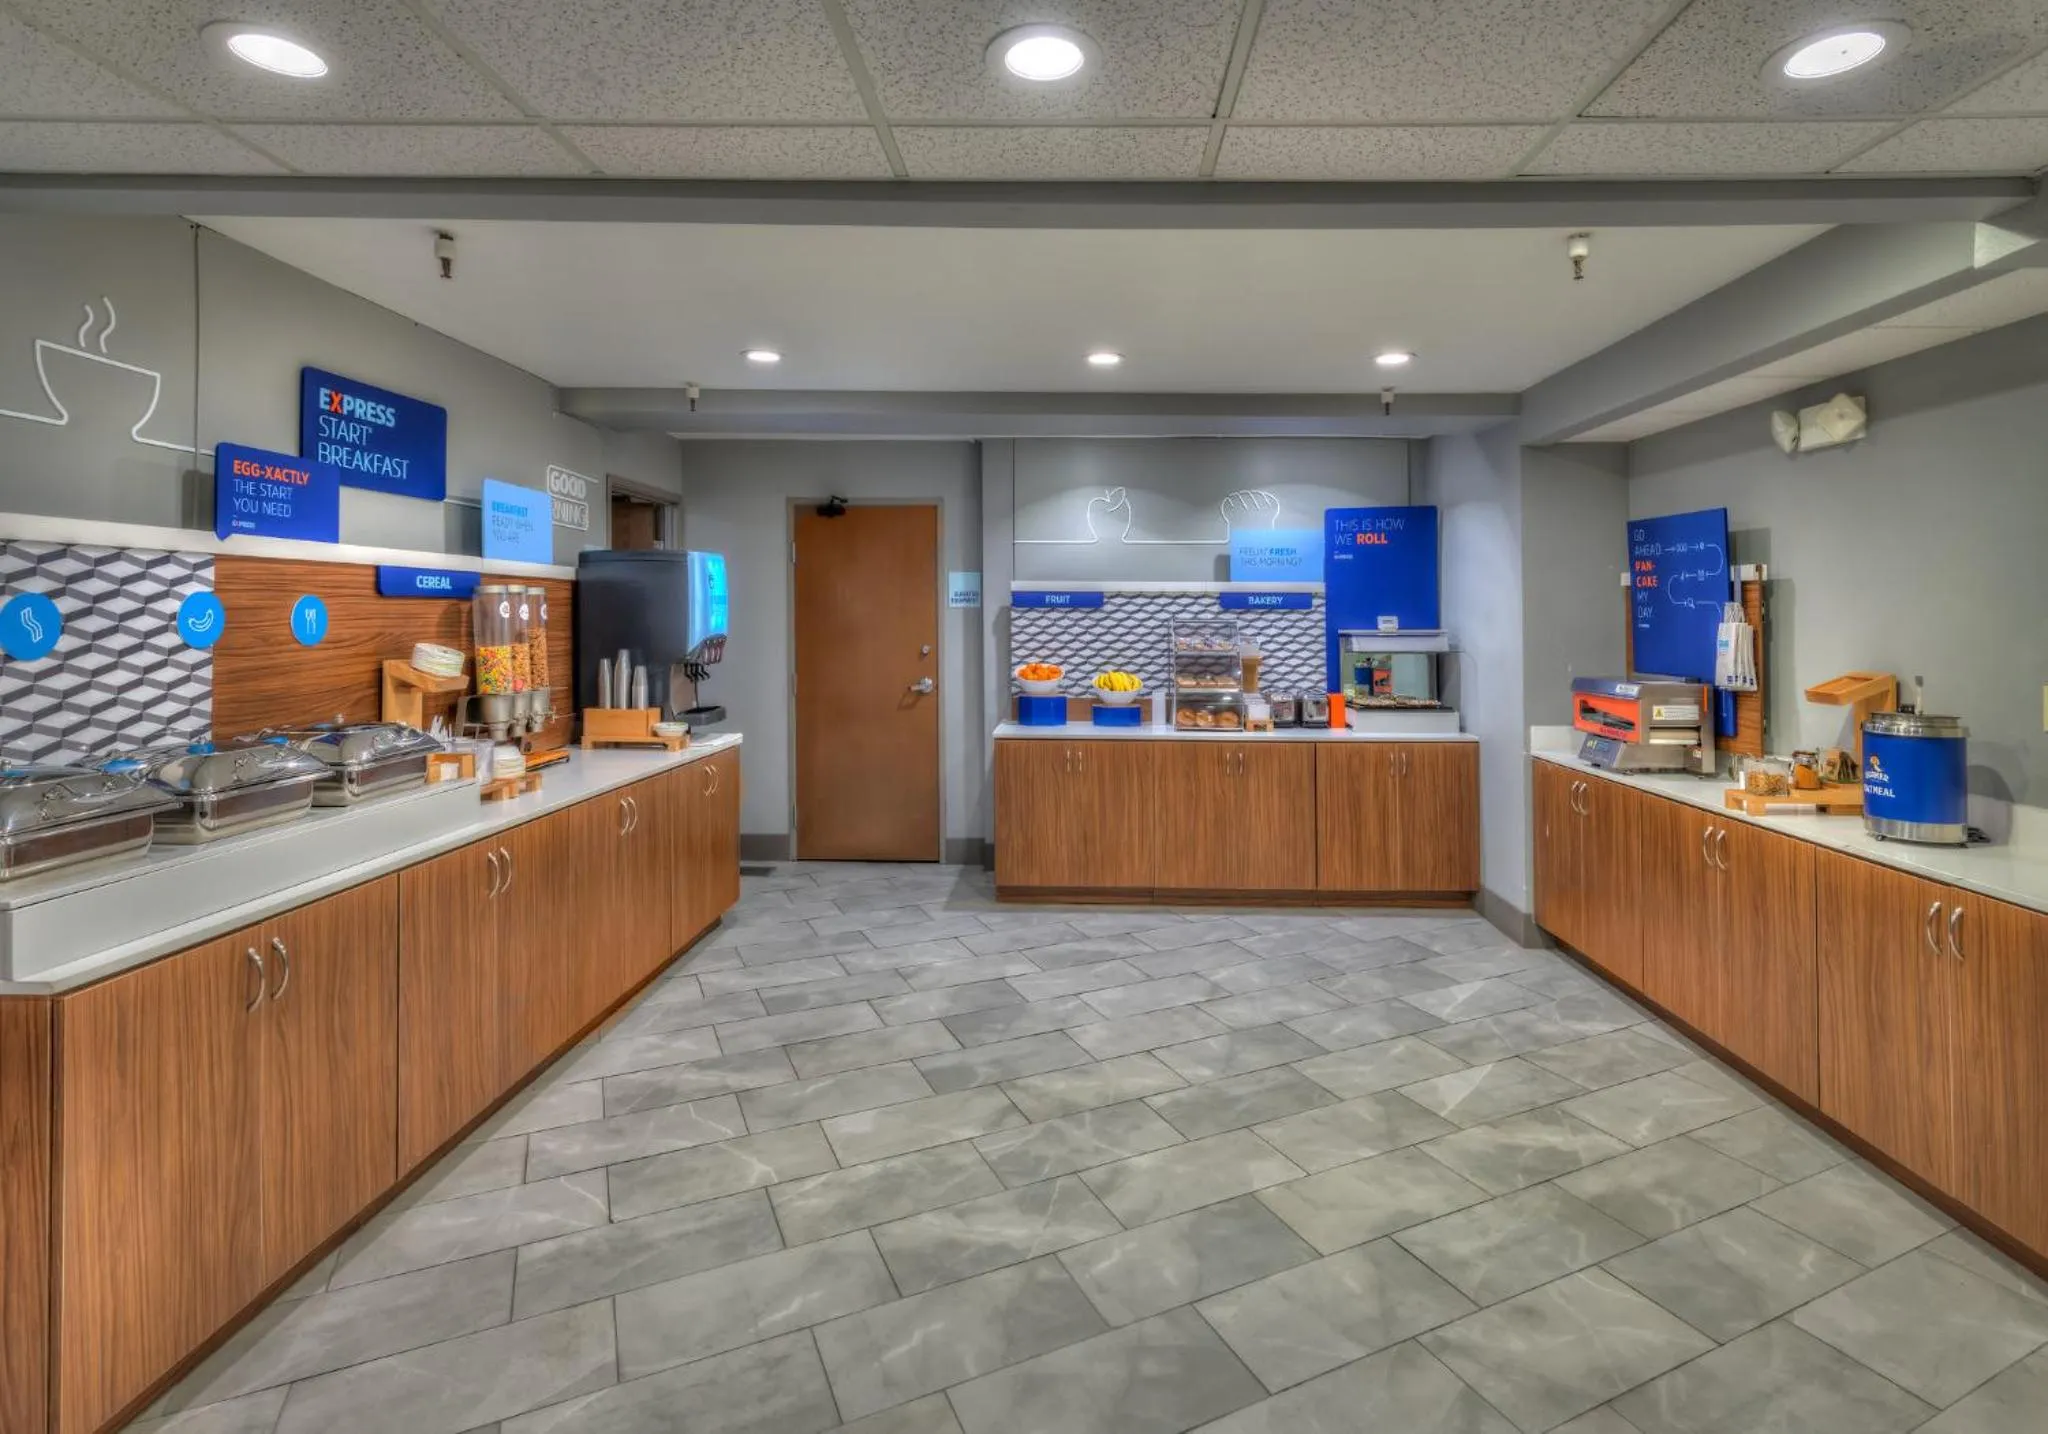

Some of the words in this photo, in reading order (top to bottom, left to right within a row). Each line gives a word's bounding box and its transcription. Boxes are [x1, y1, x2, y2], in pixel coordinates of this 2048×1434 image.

[320, 387, 396, 428] EXPRESS
[318, 442, 410, 480] BREAKFAST
[233, 459, 310, 485] EGG-XACTLY
[233, 479, 257, 496] THE
[260, 483, 293, 501] START
[551, 470, 587, 500] GOOD
[233, 497, 259, 514] YOU
[262, 502, 292, 518] NEED
[1335, 519, 1359, 530] THIS
[1361, 519, 1372, 530] IS
[1375, 518, 1405, 530] HOW
[1335, 533, 1353, 545] WE
[1356, 533, 1388, 545] ROLL
[1633, 529, 1645, 541] GO
[1269, 547, 1297, 556] FRESH
[1635, 543, 1661, 557] AHEAD
[1635, 560, 1656, 573] PAN-
[416, 575, 452, 590] CEREAL
[1636, 575, 1659, 588] CAKE
[1045, 594, 1071, 605] FRUIT
[1249, 596, 1284, 606] BAKERY
[1637, 590, 1649, 602] MY
[1638, 605, 1653, 618] DAY
